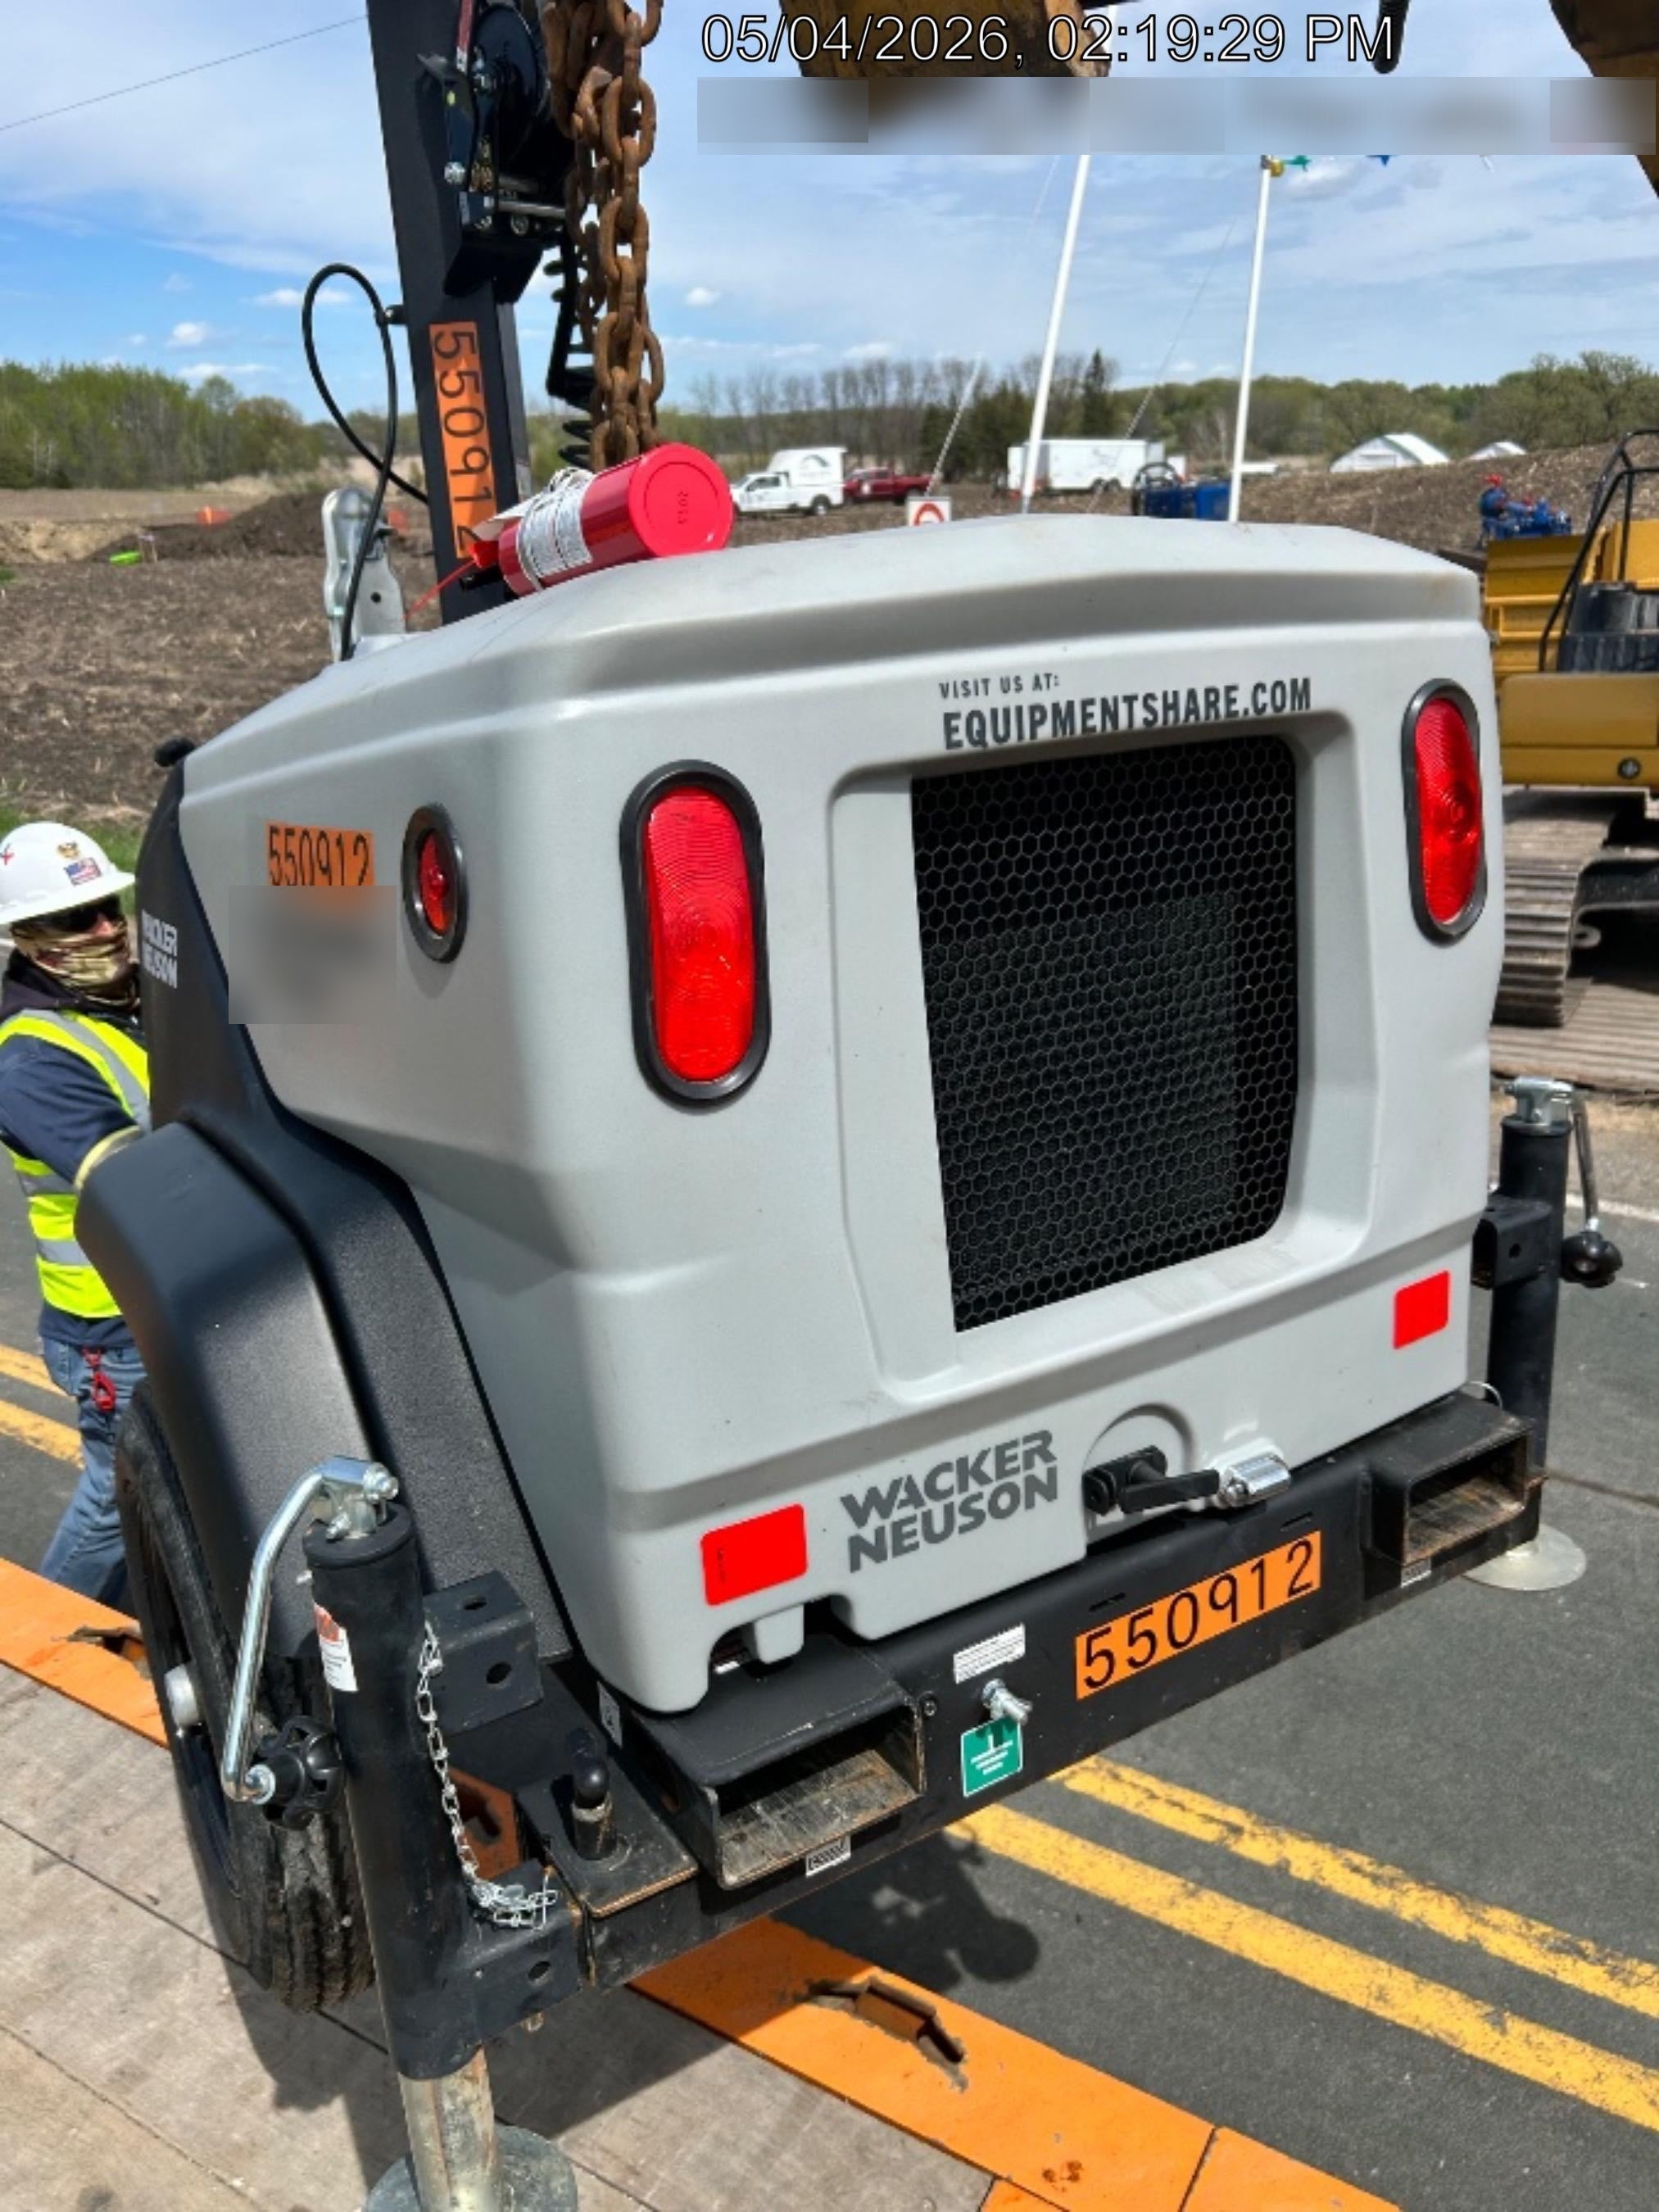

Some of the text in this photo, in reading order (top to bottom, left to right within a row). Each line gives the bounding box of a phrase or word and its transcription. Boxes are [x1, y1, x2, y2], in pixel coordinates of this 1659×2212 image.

[938, 673, 1060, 700] VISIT US AT:
[943, 678, 1312, 750] EQUIPMENTSHARE.COM
[269, 826, 369, 886] 550912
[840, 1430, 1058, 1530] WACKER
[848, 1465, 1058, 1573] NEUSON
[1084, 1539, 1314, 1690] 550912
